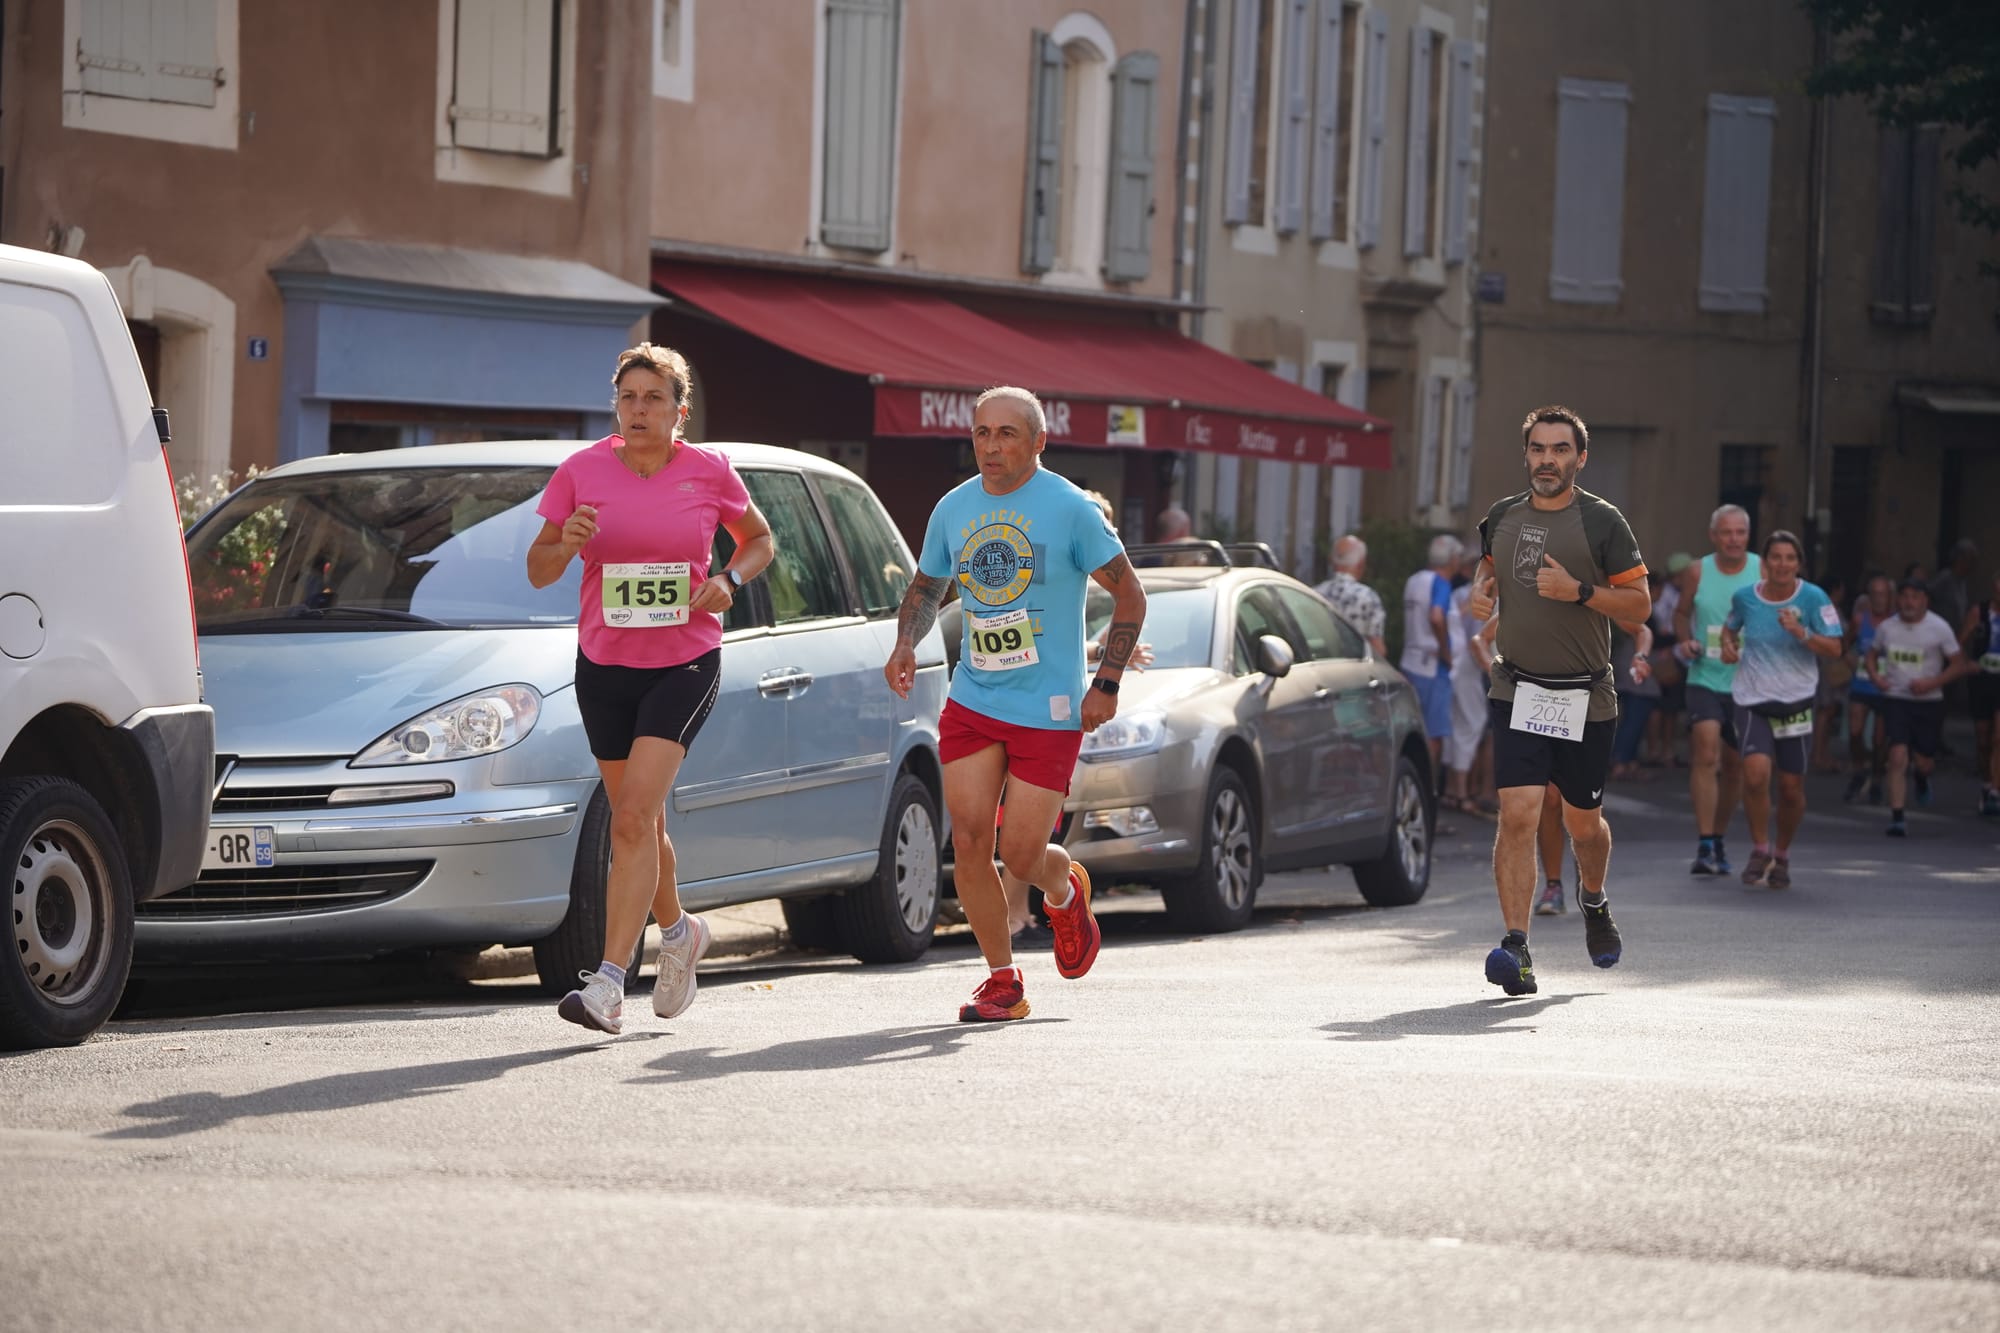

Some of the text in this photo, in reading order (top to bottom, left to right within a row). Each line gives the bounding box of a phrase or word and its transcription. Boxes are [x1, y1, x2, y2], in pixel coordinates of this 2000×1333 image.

[920, 391, 976, 428] RYAN
[1045, 401, 1071, 435] AR
[1186, 413, 1211, 445] Chez
[961, 509, 1032, 538] OFFICIAL
[1522, 533, 1543, 544] TRAIL
[1019, 557, 1032, 568] 72
[615, 580, 678, 606] 155
[972, 628, 1022, 653] 109
[1529, 703, 1569, 726] 204
[1525, 720, 1570, 737] TUFF'S
[256, 847, 271, 861] 59
